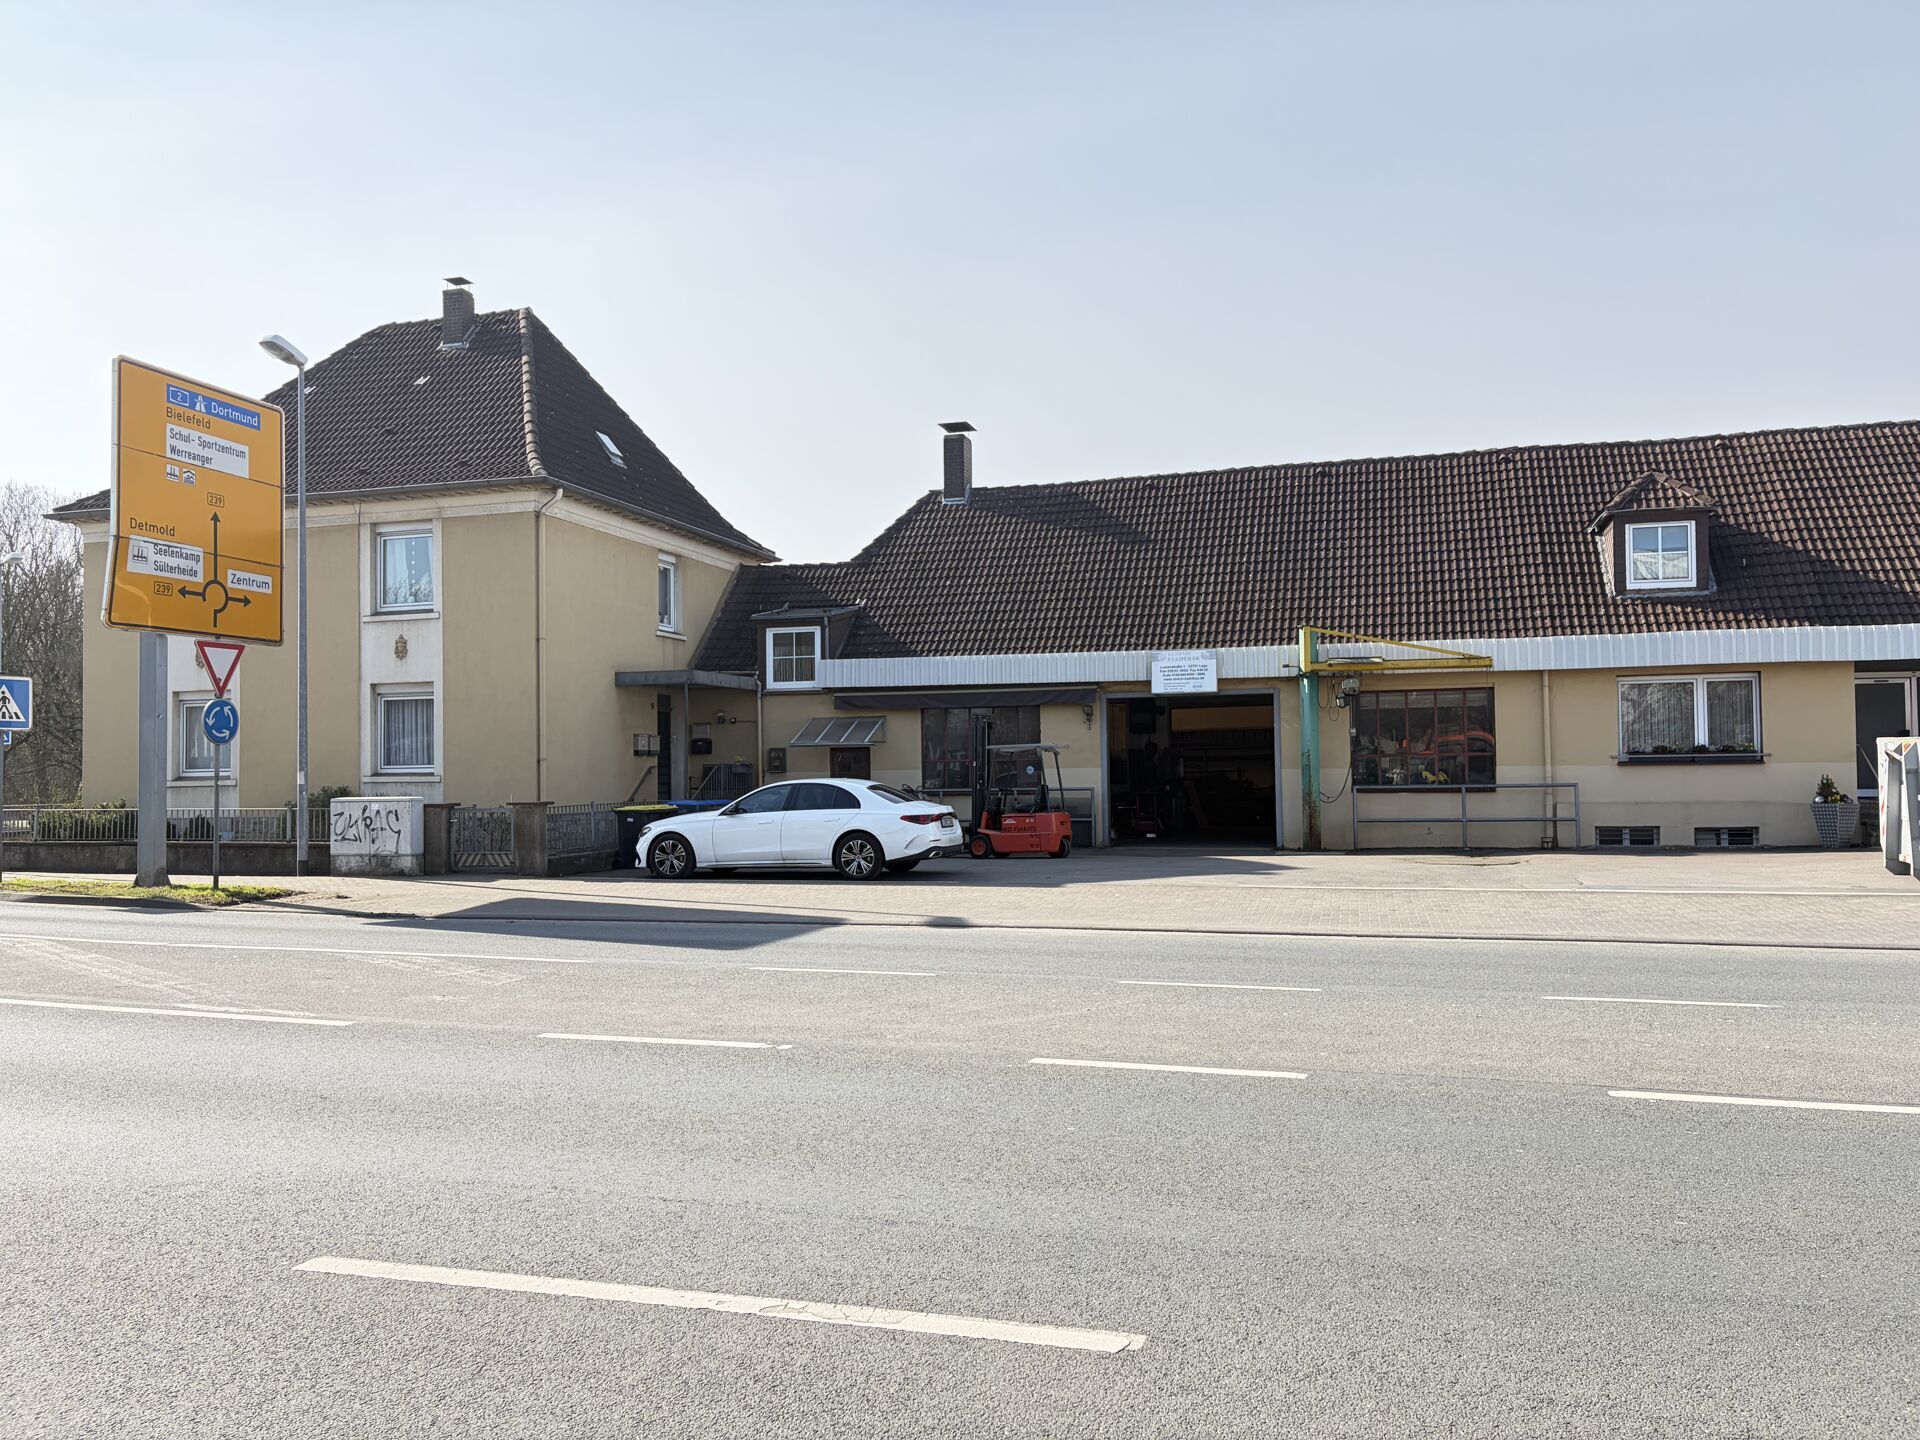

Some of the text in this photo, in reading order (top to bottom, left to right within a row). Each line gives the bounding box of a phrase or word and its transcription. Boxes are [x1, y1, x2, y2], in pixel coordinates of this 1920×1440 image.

[177, 392, 182, 402] 2
[166, 407, 211, 429] Bielefeld
[211, 402, 258, 426] Dortmund
[169, 428, 246, 459] Schul- Sportzentrum
[169, 444, 213, 466] Werreanger
[209, 495, 222, 505] 239
[129, 517, 176, 537] Detmold
[153, 543, 200, 565] Seelenkamp
[153, 560, 198, 578] Sülterheide
[156, 585, 171, 594] 239
[230, 573, 270, 590] Zentrum
